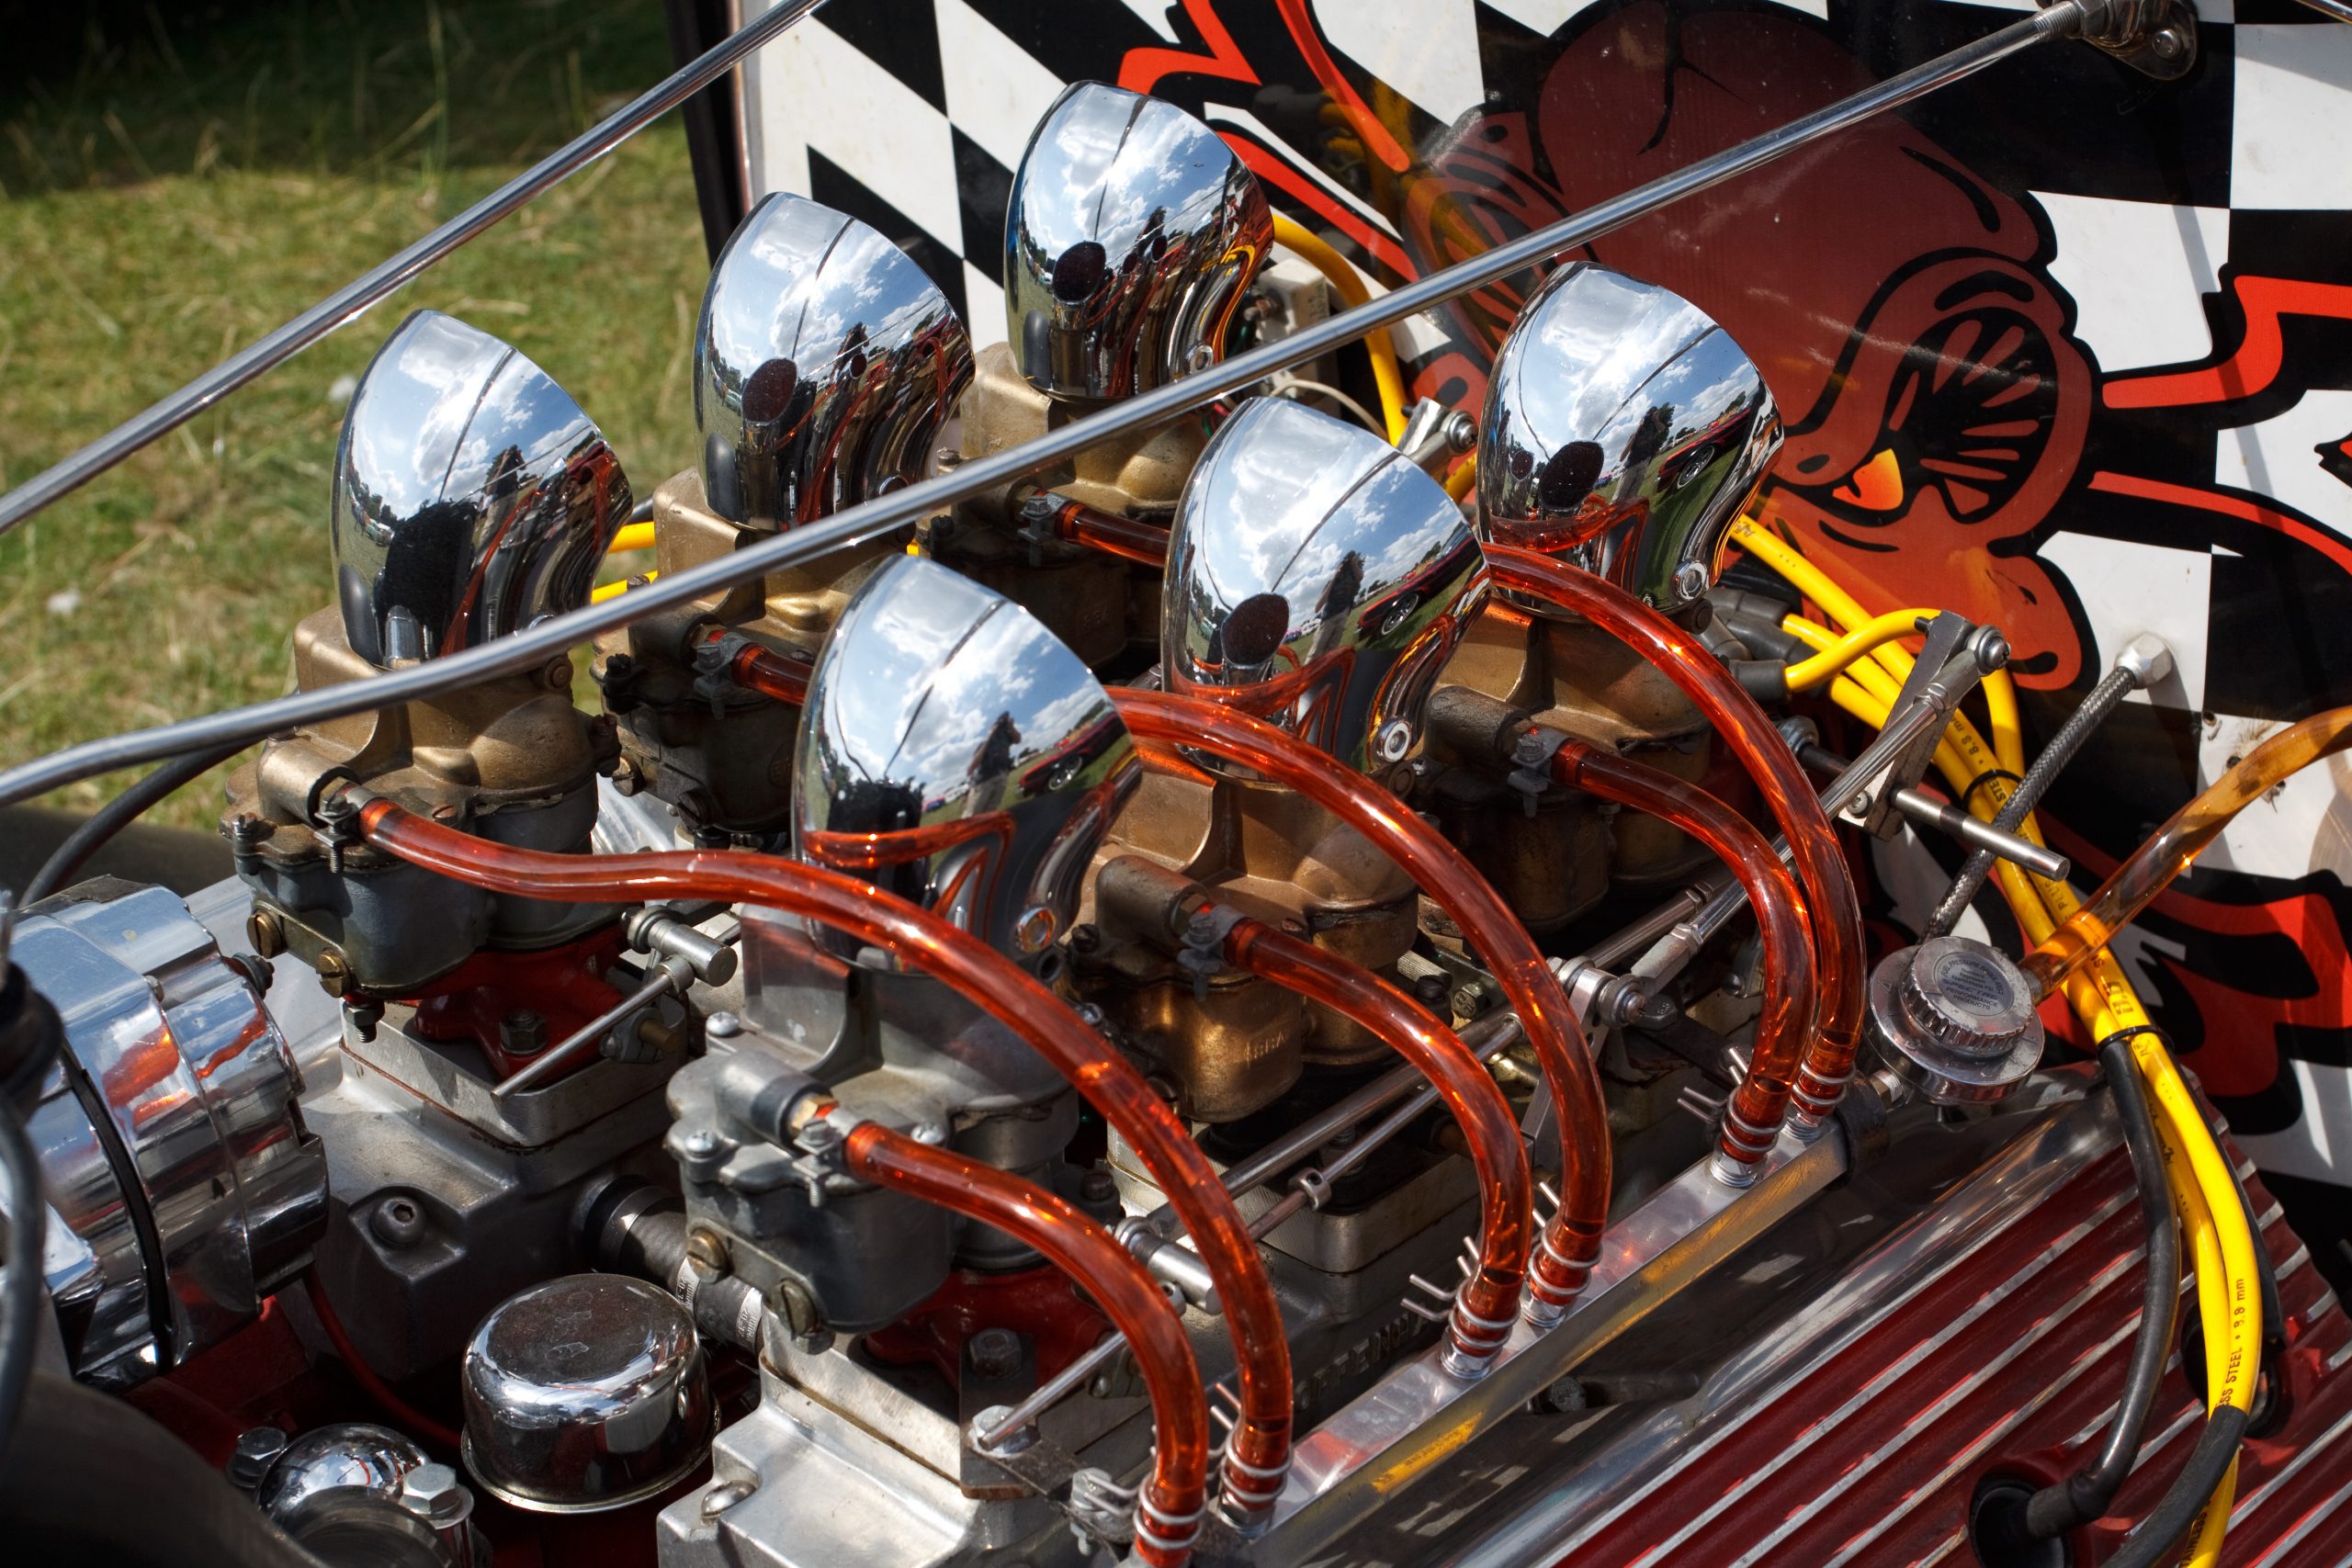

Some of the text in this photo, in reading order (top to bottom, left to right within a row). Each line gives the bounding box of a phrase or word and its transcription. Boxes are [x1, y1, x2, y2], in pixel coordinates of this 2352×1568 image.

[1946, 987, 1998, 1007] PERFORMANCE
[1953, 995, 1991, 1010] PRODUCTS
[2225, 1347, 2243, 1383] STEEL
[2235, 1278, 2245, 1302] mm
